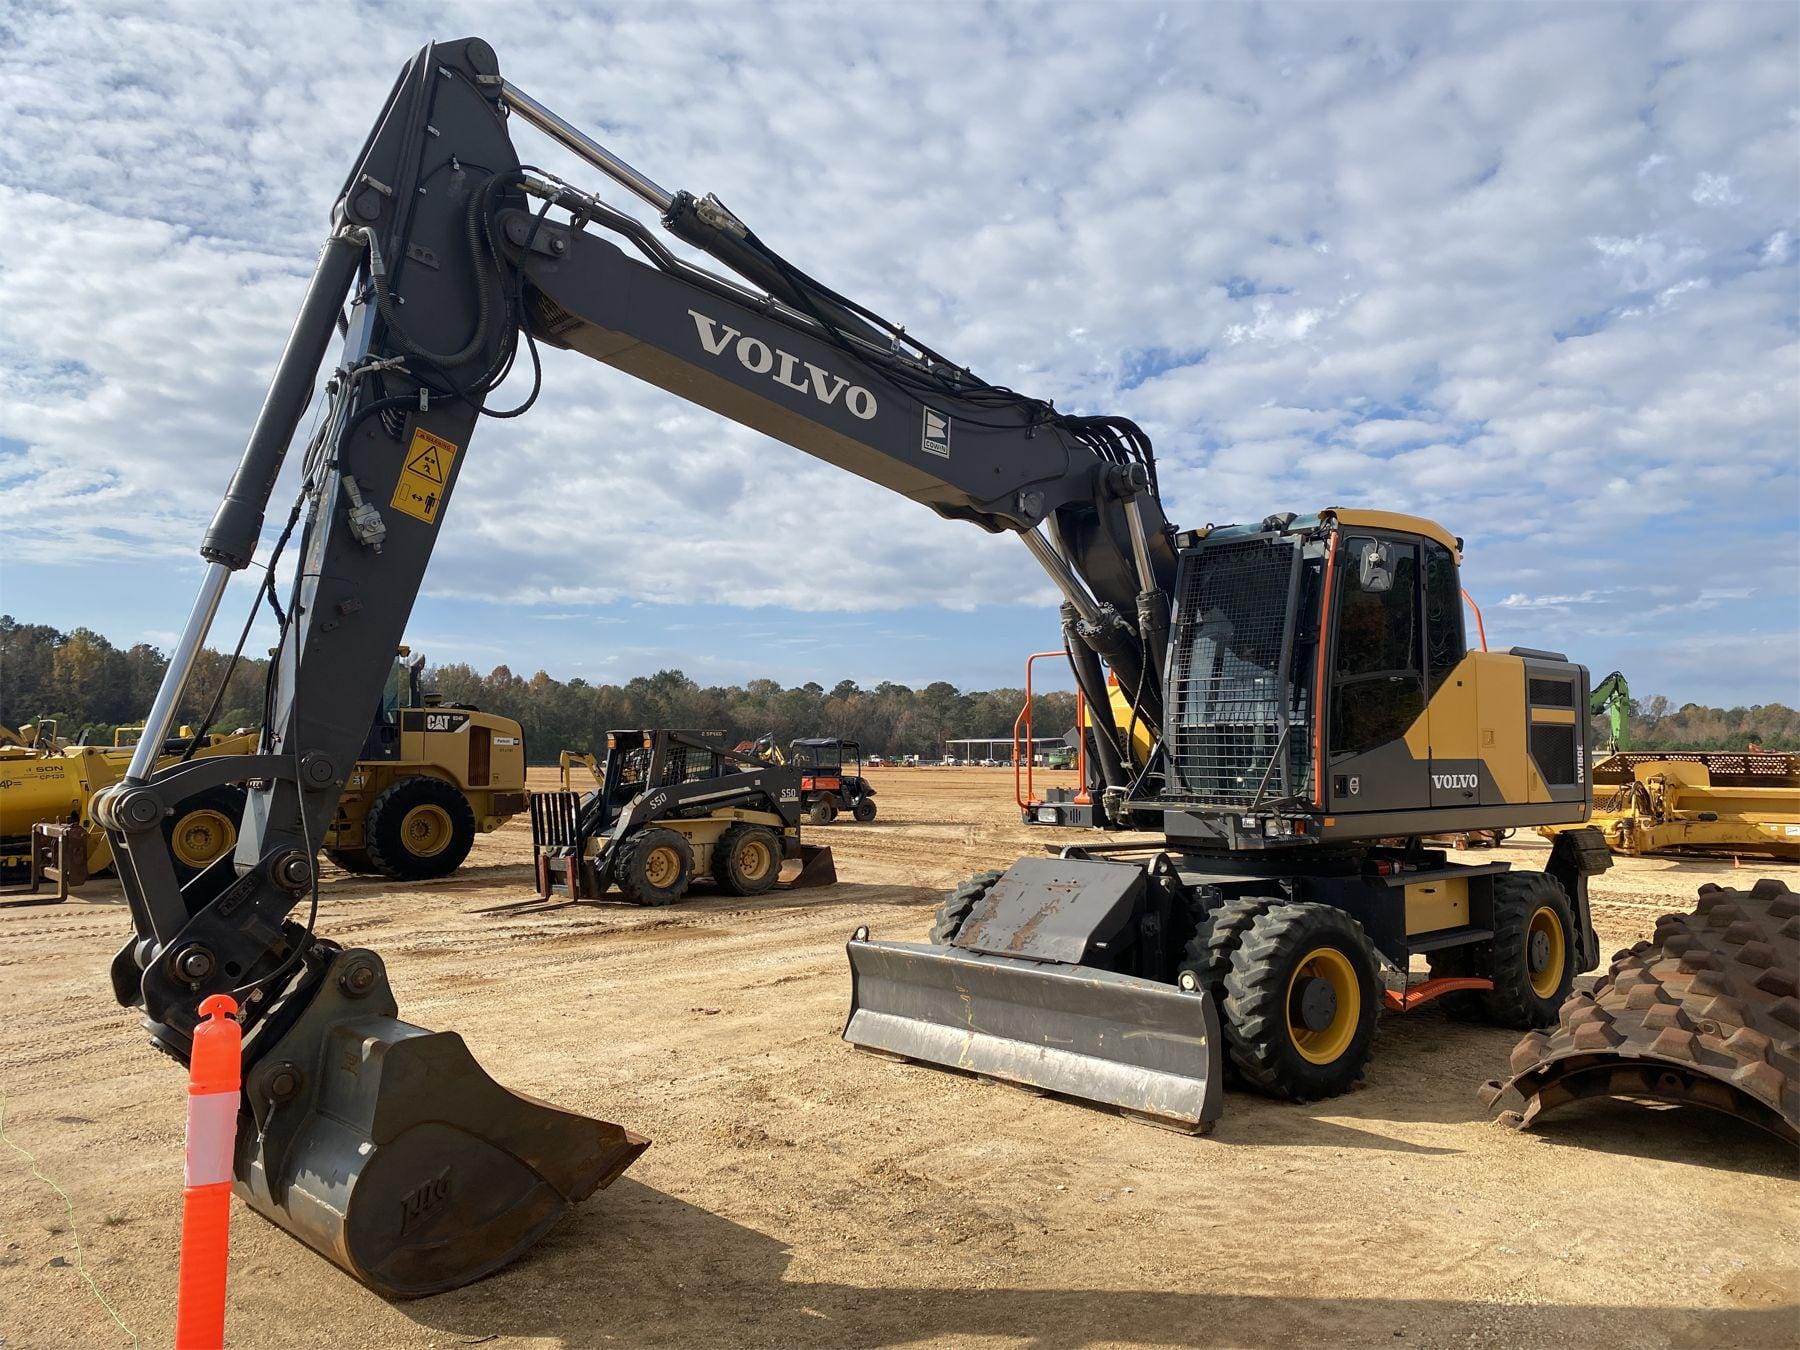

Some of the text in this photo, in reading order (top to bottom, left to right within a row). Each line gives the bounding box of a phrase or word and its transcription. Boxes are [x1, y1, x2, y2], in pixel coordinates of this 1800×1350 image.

[687, 309, 878, 420] VOLVO
[925, 440, 947, 454] COWIN
[427, 715, 450, 730] CAT
[1432, 774, 1479, 789] VOLVO
[781, 788, 796, 798] S50
[649, 792, 668, 810] S50
